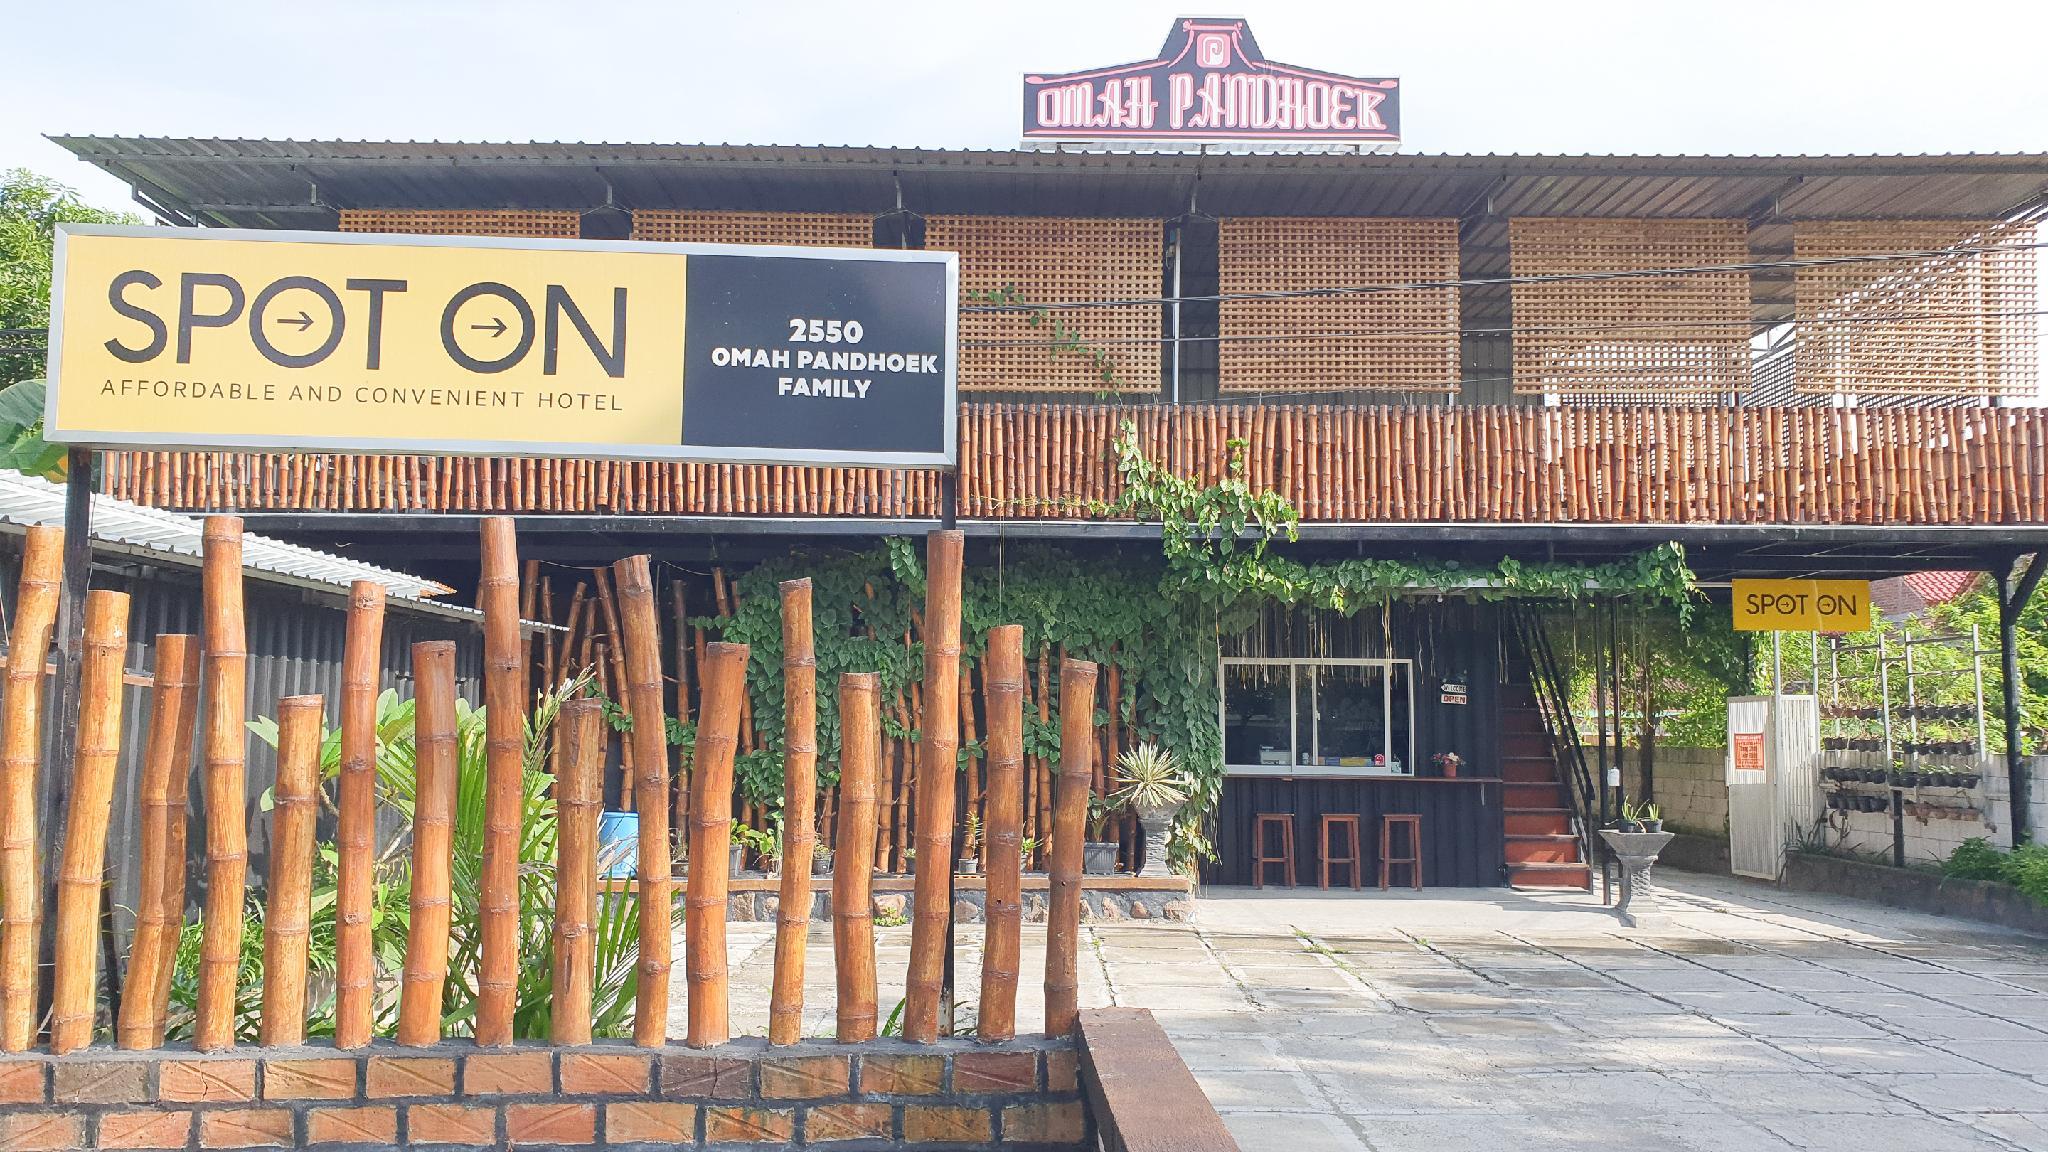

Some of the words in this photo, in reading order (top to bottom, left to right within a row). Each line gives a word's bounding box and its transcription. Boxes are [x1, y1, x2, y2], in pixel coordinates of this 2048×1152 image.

[1036, 76, 1158, 128] OMAH
[1168, 73, 1387, 130] PANDHOEK
[104, 269, 408, 370] SPOT
[440, 281, 628, 379] ON
[788, 318, 864, 344] 2550
[711, 347, 790, 369] OMAH
[797, 350, 938, 374] PANDHOEK
[101, 379, 276, 401] AFFORDABLE
[289, 385, 342, 402] AND
[355, 387, 525, 408] CONVENIENT
[539, 392, 623, 411] HOTEL
[778, 377, 872, 399] FAMILY
[1746, 593, 1809, 616] SPOT
[1817, 594, 1857, 616] ON
[1443, 695, 1466, 704] OPEN
